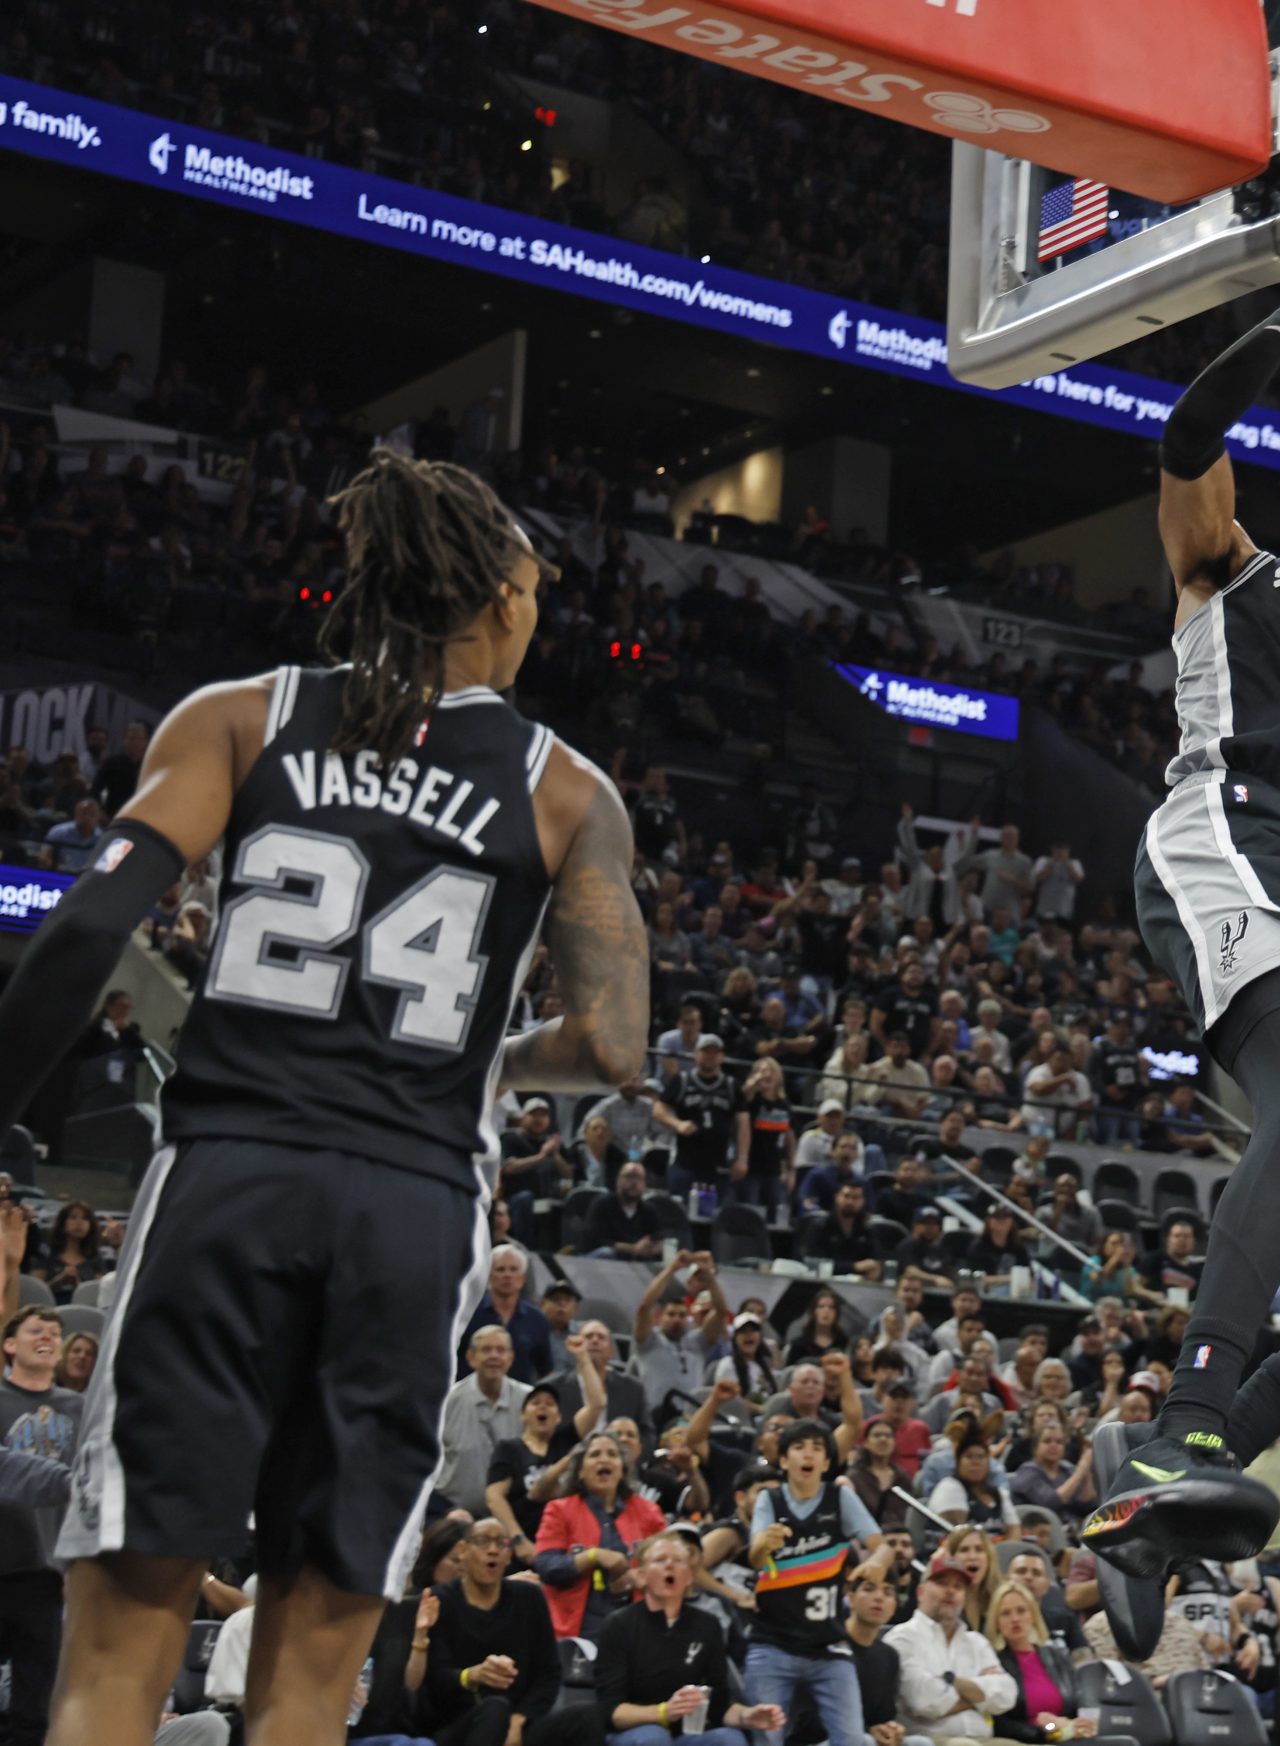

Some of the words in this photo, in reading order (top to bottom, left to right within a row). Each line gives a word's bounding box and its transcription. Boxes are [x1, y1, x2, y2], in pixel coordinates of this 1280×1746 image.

[12, 101, 101, 149] family.
[184, 169, 278, 203] HEALTHCARE
[185, 144, 314, 200] Methodist
[357, 194, 427, 234] Learn
[432, 218, 496, 252] more
[499, 232, 527, 261] at
[530, 239, 793, 329] SAHealth.com/womens
[857, 319, 948, 364] Methodis
[1057, 372, 1103, 406] here
[1104, 384, 1136, 413] for
[1135, 397, 1174, 422] you
[887, 681, 987, 721] Methodist
[282, 749, 501, 857] VASSELL
[204, 823, 498, 1053] 24
[805, 1585, 838, 1621] 31
